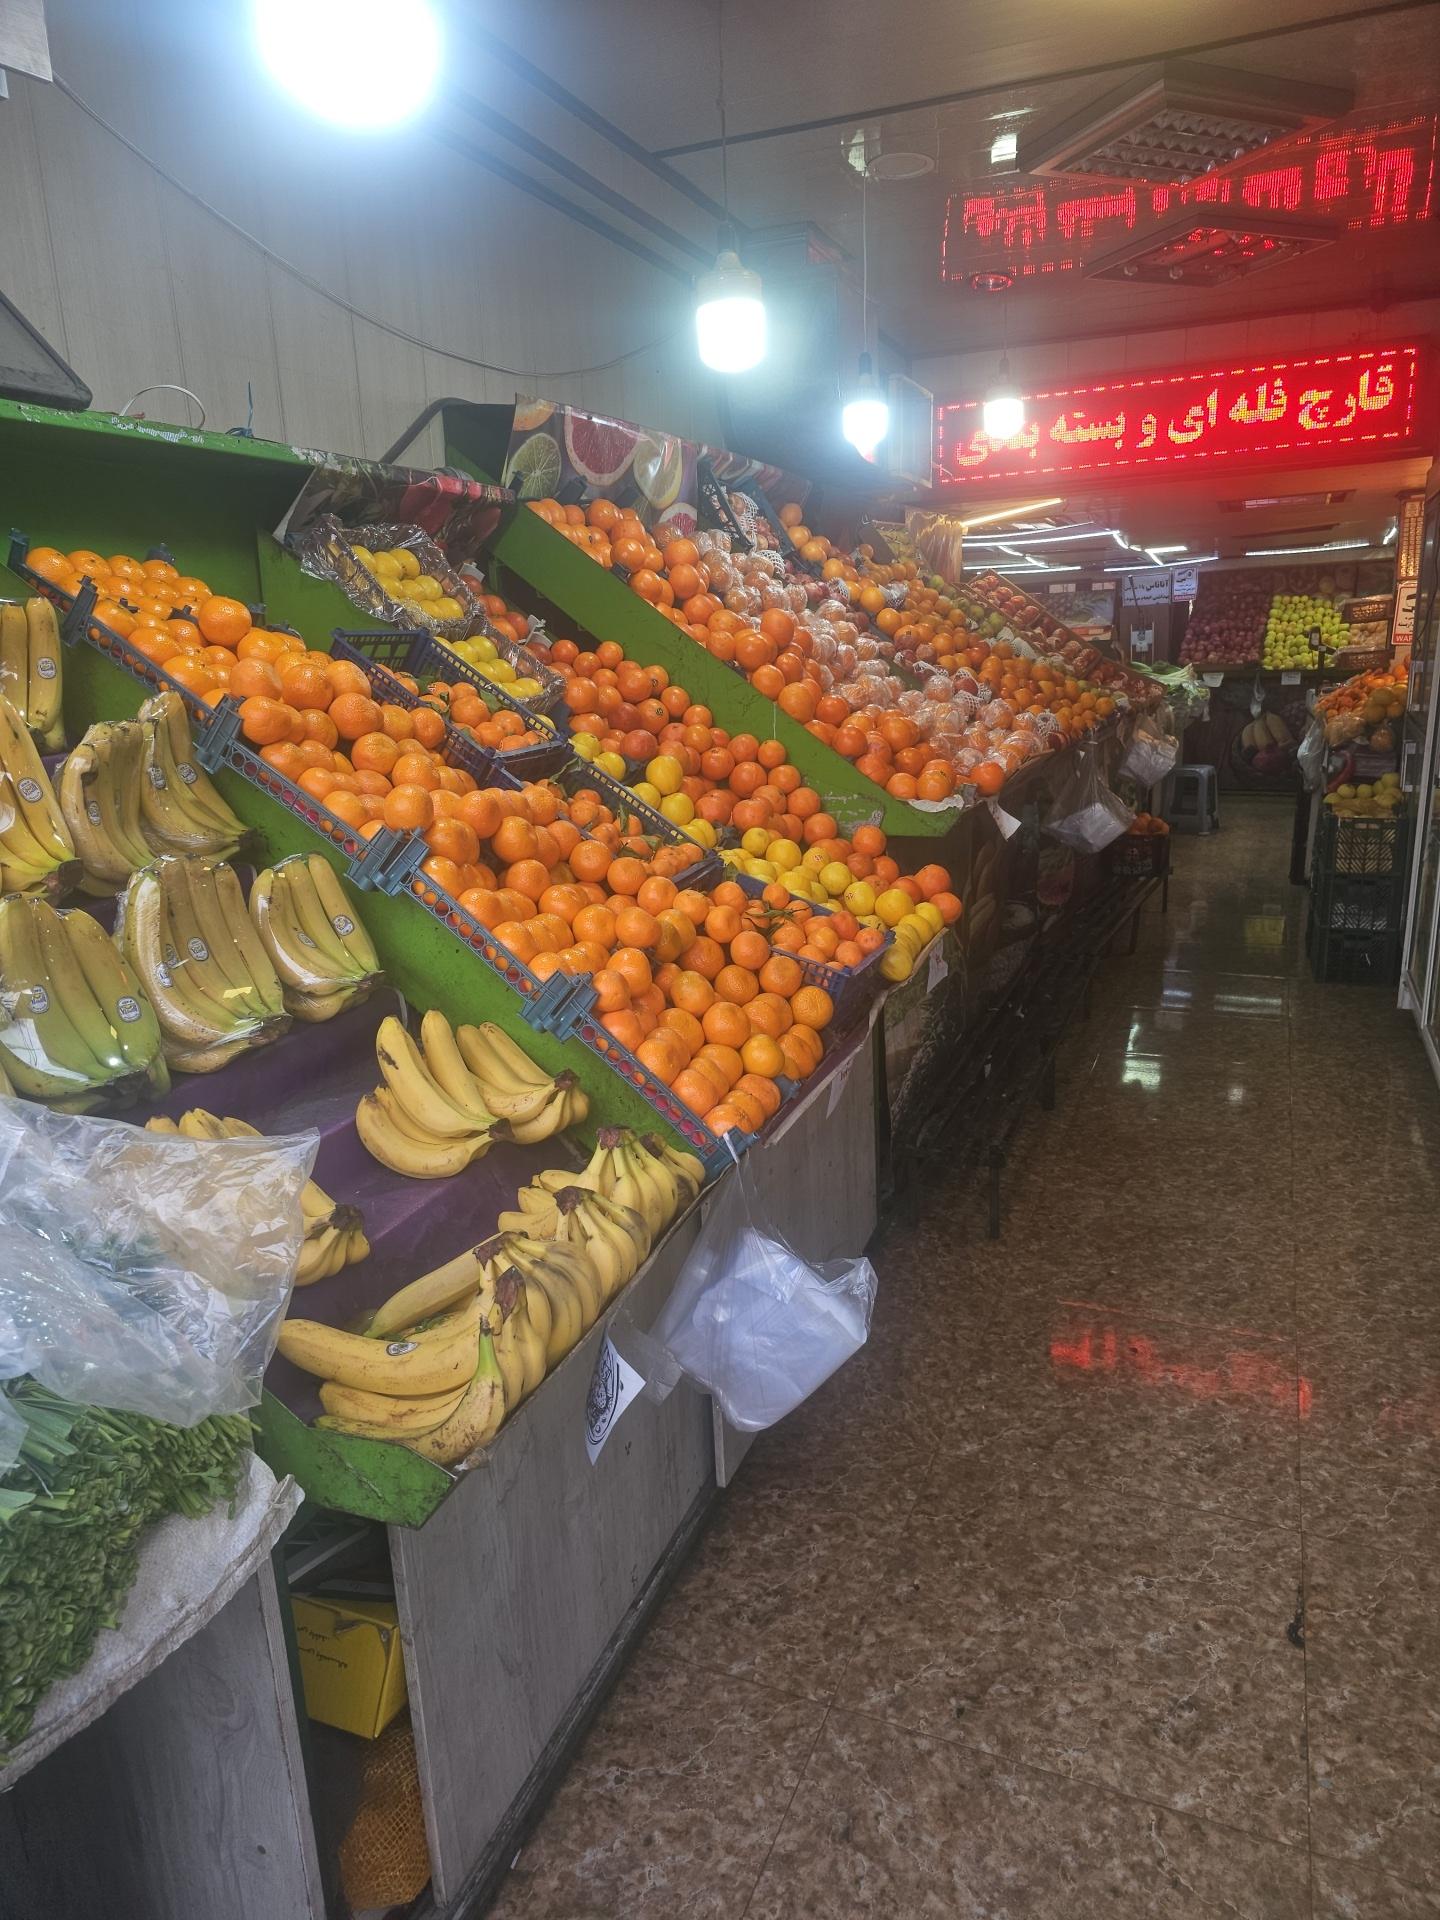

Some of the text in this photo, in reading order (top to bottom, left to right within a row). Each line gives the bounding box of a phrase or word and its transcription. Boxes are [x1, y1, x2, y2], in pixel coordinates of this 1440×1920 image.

[1167, 388, 1218, 444] ای
[1228, 377, 1288, 424] فله
[1298, 364, 1394, 430] قارچ
[1050, 411, 1126, 450] بسته
[1136, 413, 1157, 448] و
